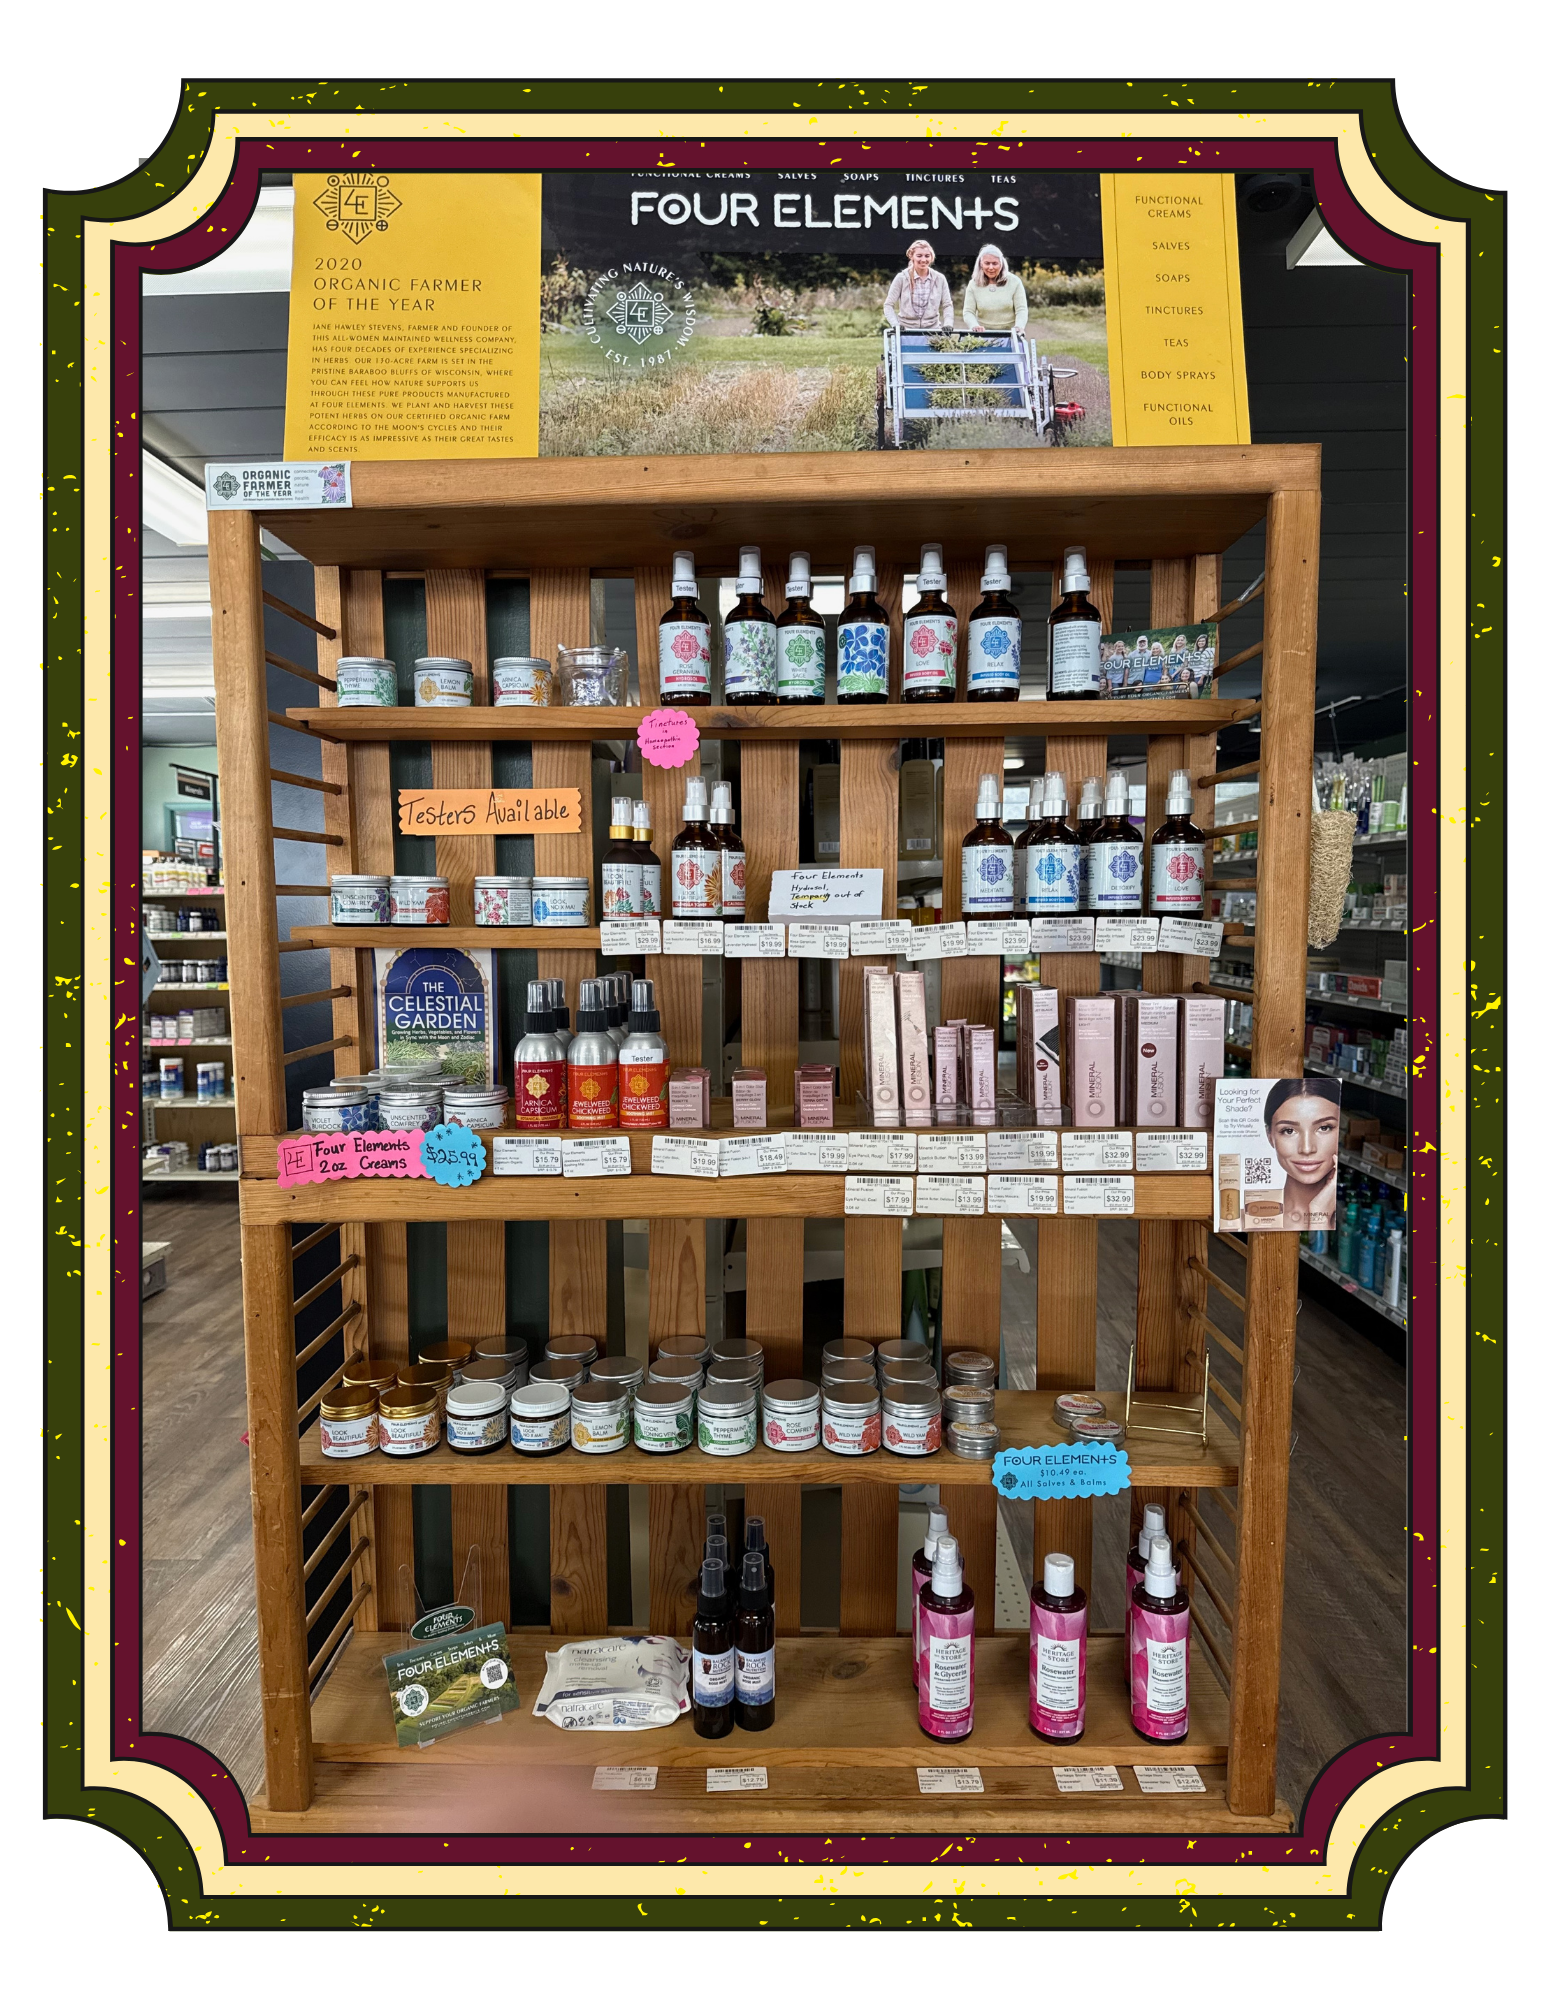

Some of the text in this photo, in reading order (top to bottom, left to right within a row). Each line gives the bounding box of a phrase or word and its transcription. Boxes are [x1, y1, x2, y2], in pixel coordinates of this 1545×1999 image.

[844, 173, 879, 181] SOAPS
[906, 174, 965, 182] TINCTURES
[991, 175, 1018, 183] TEAS
[1135, 196, 1203, 205] FUNCTIONAL
[631, 191, 760, 227] FOUR
[1148, 209, 1191, 218] CREAMS
[1152, 242, 1190, 250] SALVES
[315, 257, 363, 271] 2020
[1155, 274, 1190, 283] SOAPS
[313, 278, 482, 292] ORGANIC FARMER
[313, 298, 435, 312] OF THE YEAR
[583, 262, 696, 346] CULTIVATING NATURE'S WISDOM
[1145, 306, 1203, 315] TINCTURES
[1164, 339, 1189, 347] TEAS
[605, 349, 671, 367] EST. 1987
[1141, 371, 1216, 380] BODY SPRAYS
[1144, 404, 1213, 412] FUNCTIONAL
[1169, 417, 1193, 426] OILS
[243, 470, 291, 480] ORGANIC
[243, 481, 291, 490] FARMER
[923, 578, 941, 586] Tester
[649, 718, 688, 728] Tinctures
[400, 791, 570, 826] Testers Available
[822, 871, 864, 880] Elements
[423, 982, 444, 992] THE
[389, 995, 483, 1012] CELESTIAL
[395, 1013, 477, 1029] GARDEN
[631, 1055, 654, 1063] Tester
[1219, 1088, 1247, 1096] Looking
[572, 1100, 611, 1108] JEWELWEED
[1236, 1096, 1261, 1104] Perfect
[521, 1106, 557, 1114] CAPSICUM
[572, 1107, 611, 1115] CHICKWEED
[313, 1137, 410, 1157] Four Elements
[426, 1143, 479, 1168] $25.99
[759, 1154, 783, 1163] $18.49
[889, 1152, 914, 1160] $17.99
[1104, 1151, 1129, 1159] $32.99
[360, 1156, 407, 1170] Creams
[535, 1156, 559, 1164] $15.79
[692, 1157, 716, 1166] $19.99
[786, 1426, 812, 1434] COMFREY
[1004, 1456, 1042, 1466] FOUR
[1040, 1469, 1070, 1477] $10.49
[1020, 1480, 1033, 1488] All
[1039, 1479, 1065, 1487] Salves
[1080, 1478, 1107, 1486] Balms
[433, 1612, 453, 1623] FOUR
[425, 1615, 463, 1632] ELEMENTS
[572, 1644, 627, 1655] natracare
[935, 1647, 966, 1655] HERITAGE
[574, 1656, 617, 1664] cleansing
[713, 1661, 731, 1669] ROCK
[934, 1662, 967, 1671] Rosewater
[398, 1661, 433, 1681] FOUR
[940, 1669, 967, 1678] Glycerin
[561, 1702, 605, 1712] natracare
